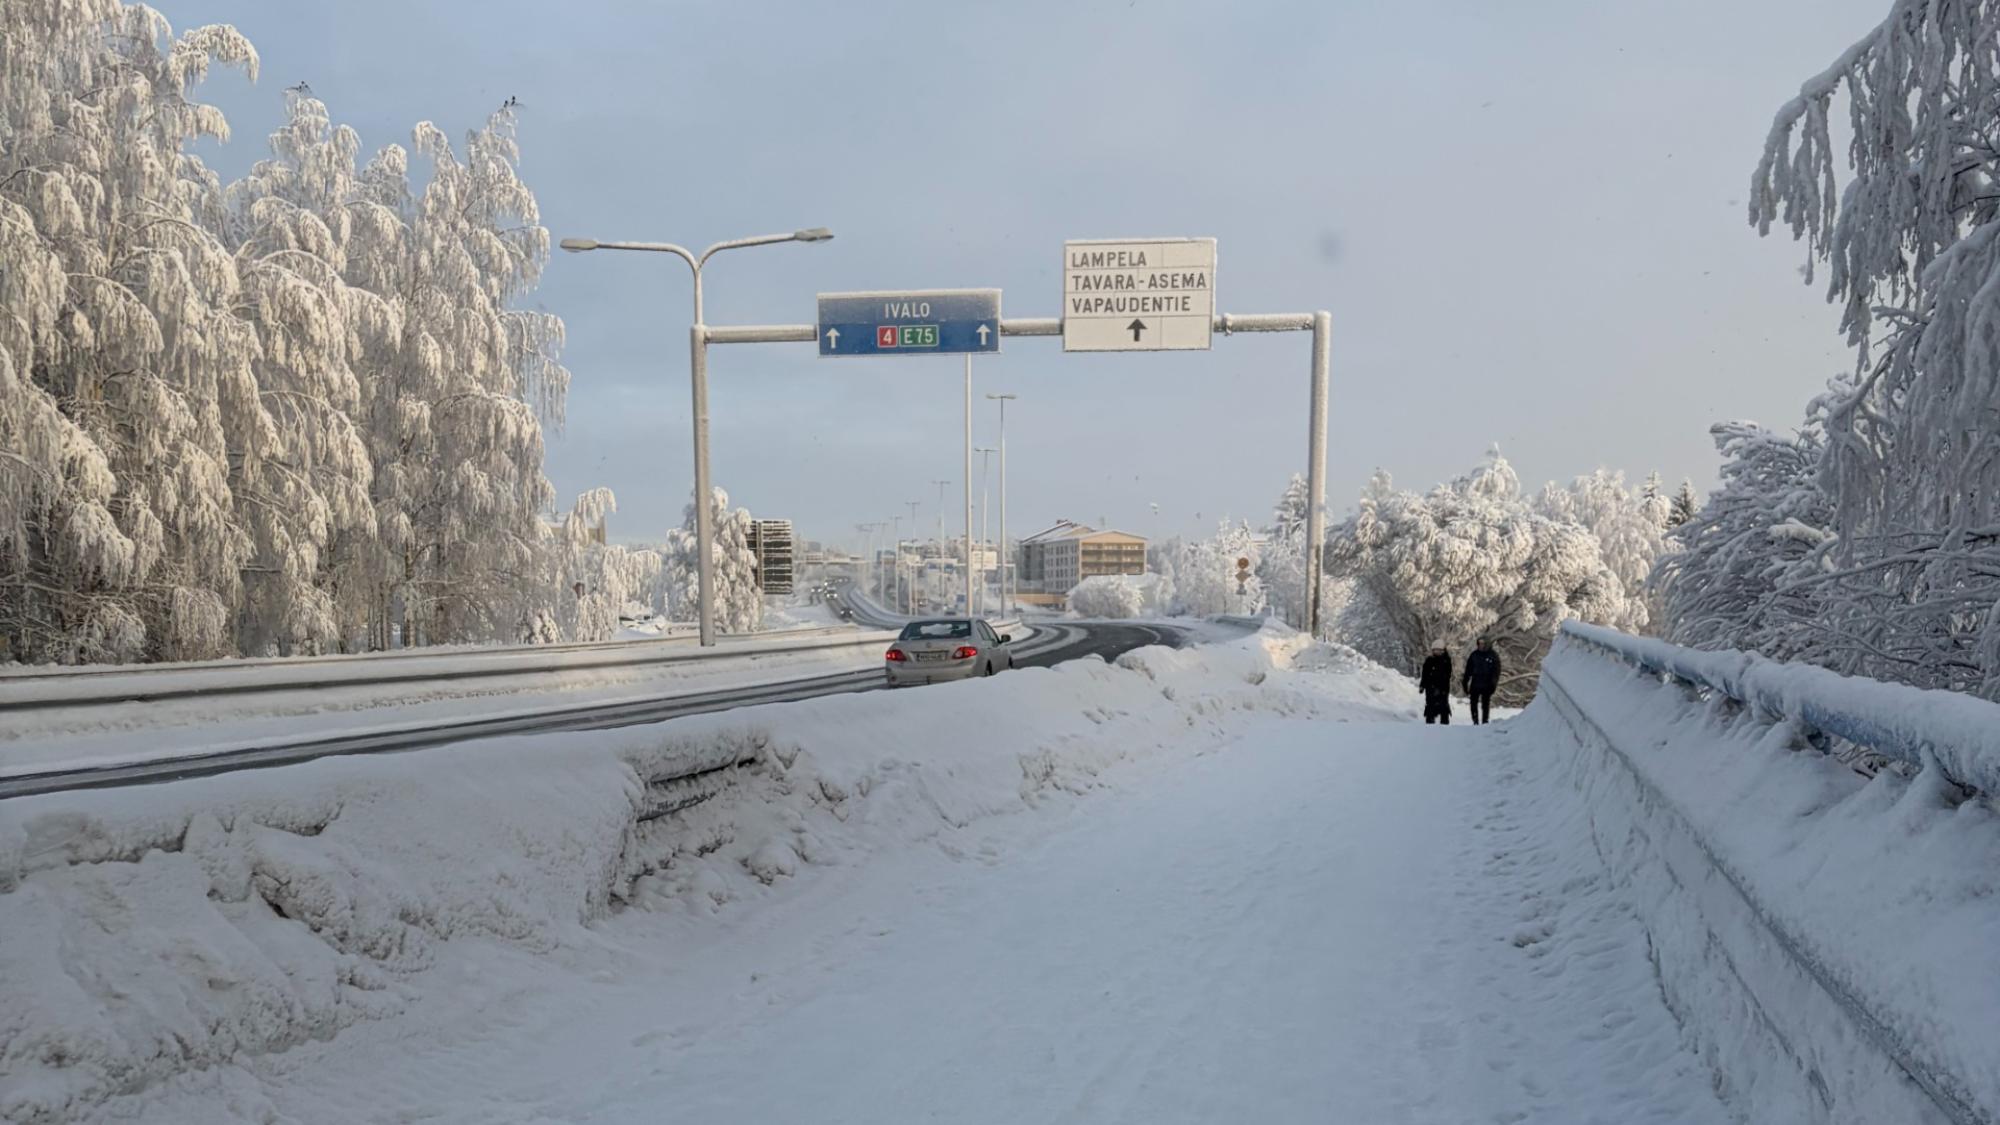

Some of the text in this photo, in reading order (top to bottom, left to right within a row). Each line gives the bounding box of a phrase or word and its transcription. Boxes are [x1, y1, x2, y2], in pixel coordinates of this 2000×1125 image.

[1072, 251, 1147, 267] LAMPELA
[1072, 273, 1206, 290] TAVARA-ASEMA
[885, 302, 930, 317] IVALO
[1072, 296, 1191, 313] VAPAUDENTIE
[883, 329, 892, 344] 4
